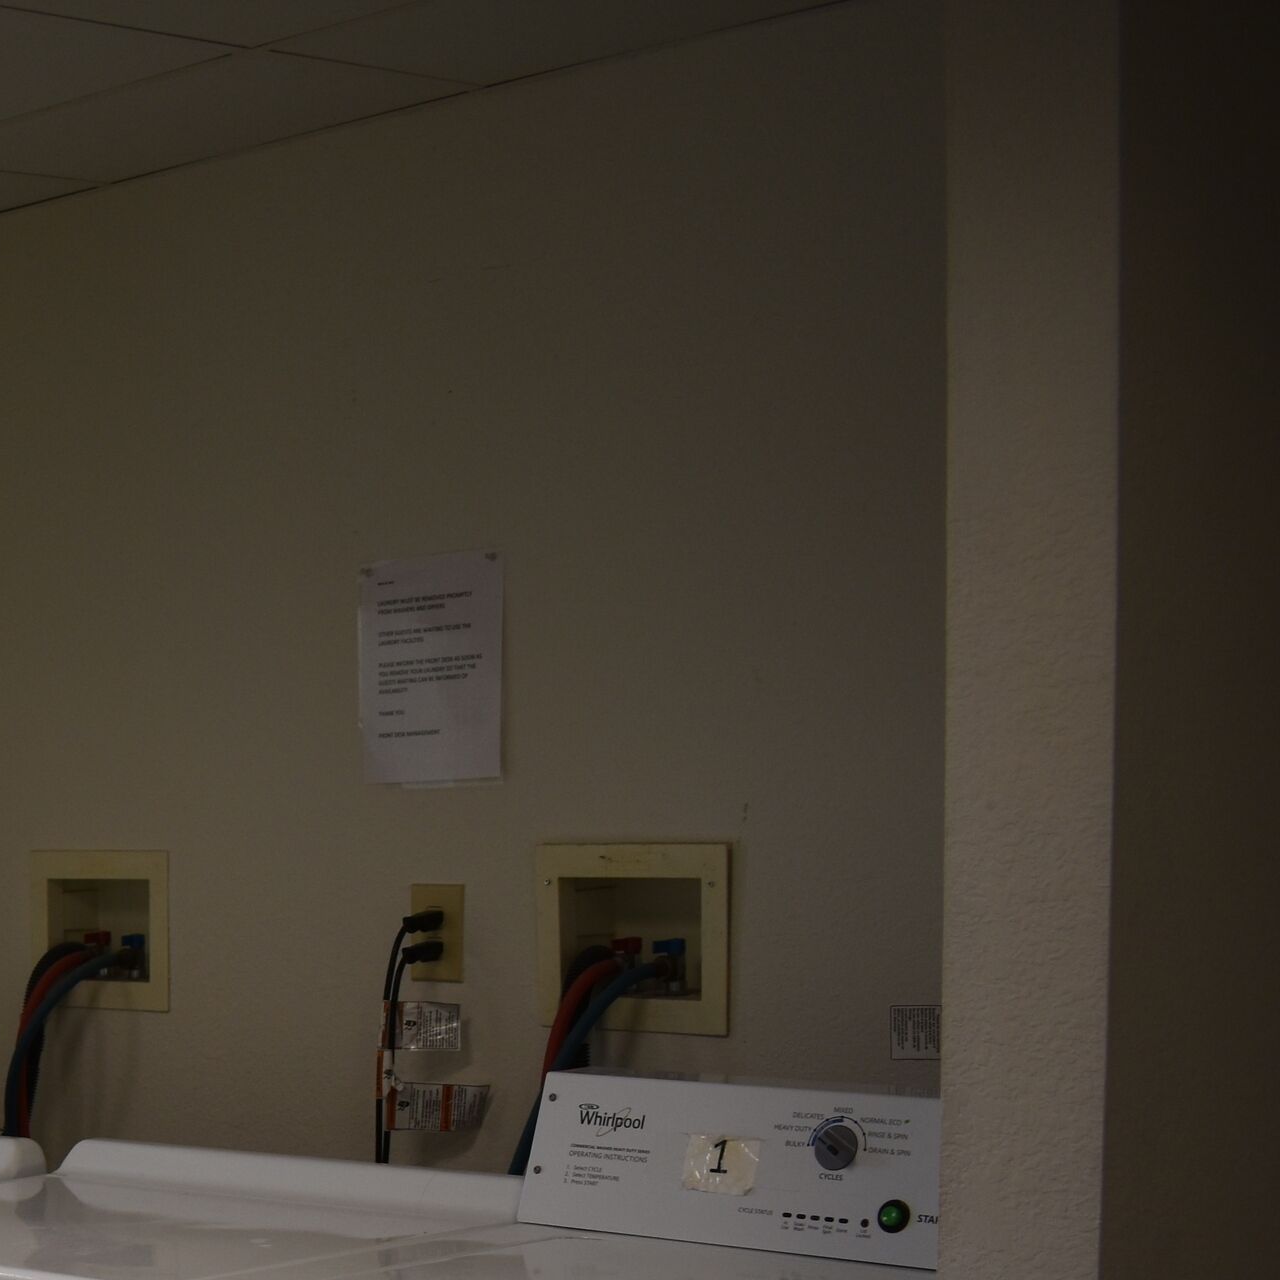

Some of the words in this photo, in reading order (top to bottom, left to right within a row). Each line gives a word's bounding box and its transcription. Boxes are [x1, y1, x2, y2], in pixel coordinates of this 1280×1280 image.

[580, 1110, 646, 1132] Whirlpool
[792, 1112, 825, 1121] DELICATES
[860, 1117, 888, 1126] NORMAL
[774, 1124, 793, 1132] HEAVY
[710, 1139, 728, 1174] 1
[869, 1147, 890, 1155] DRAIN
[896, 1149, 911, 1157] SPIN
[569, 1151, 602, 1160] OPERATING
[603, 1154, 649, 1164] INSTRUCTIONS
[588, 1173, 620, 1182] TEMPERATURE
[819, 1173, 844, 1182] CYCLES
